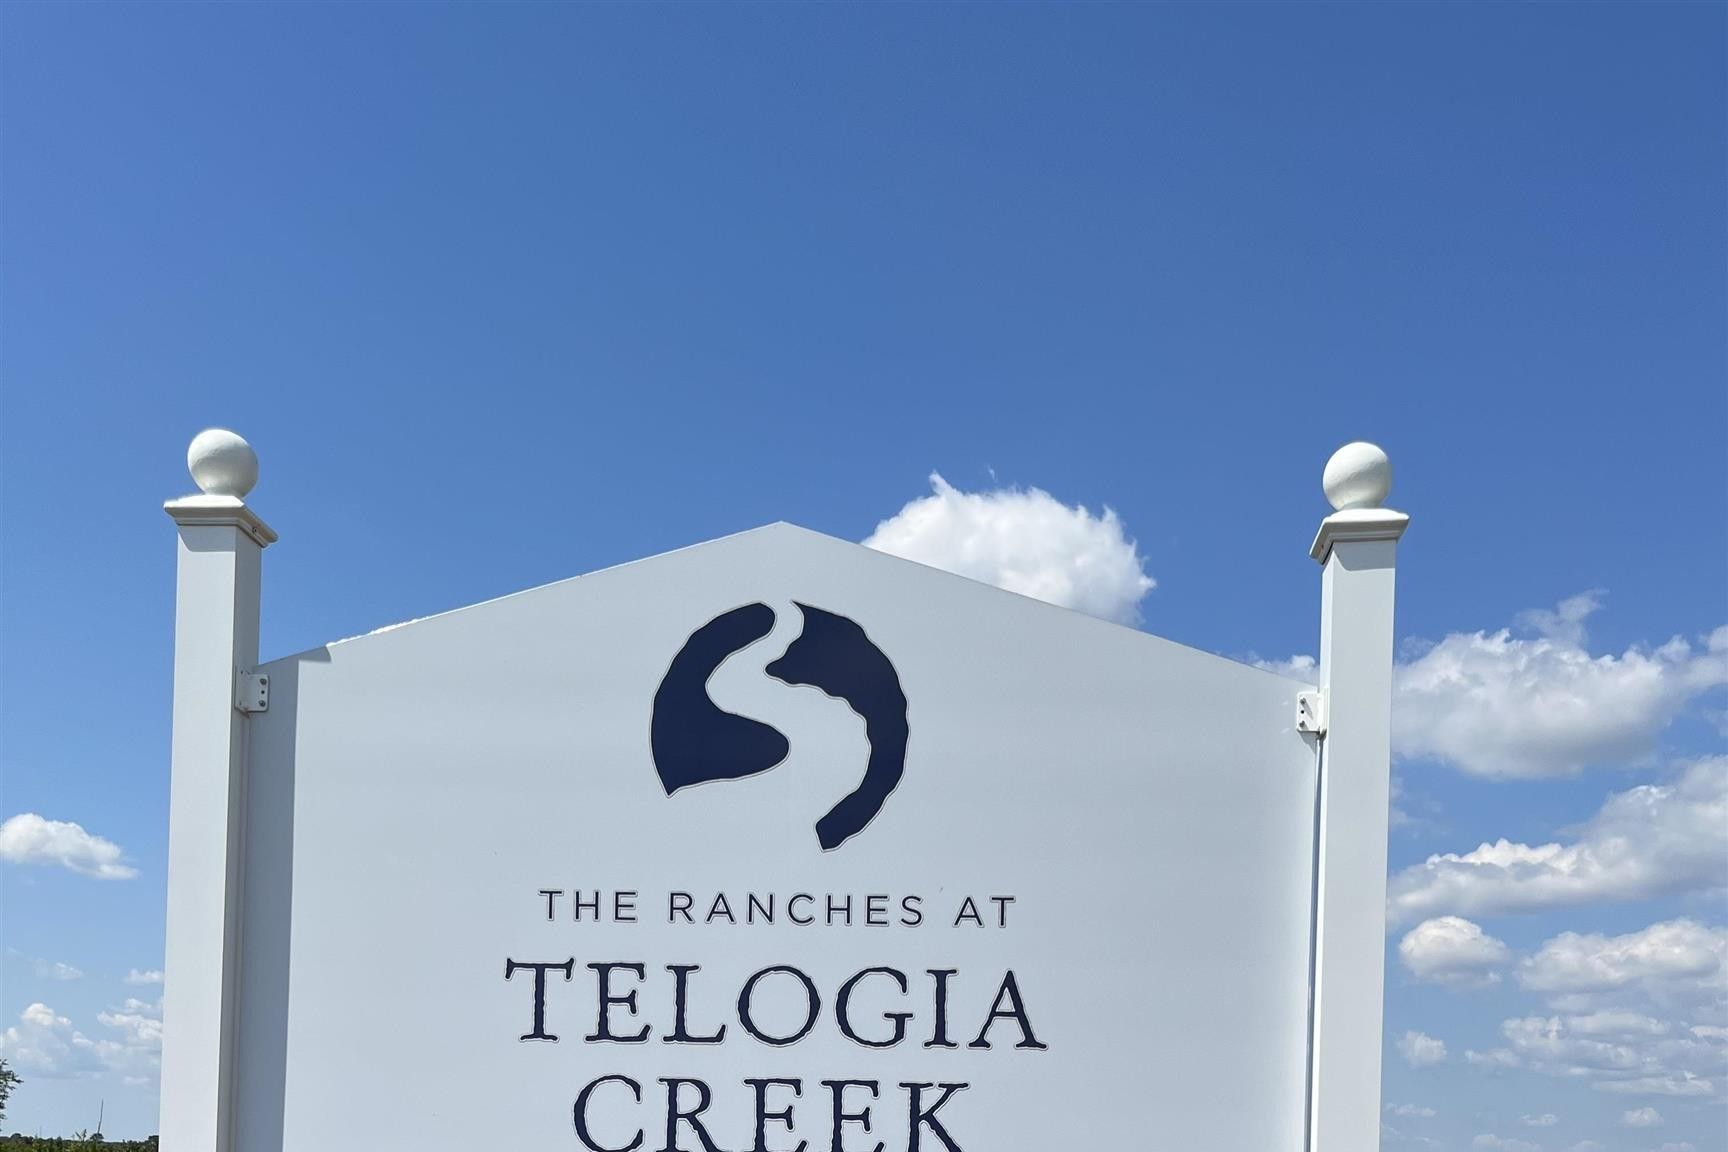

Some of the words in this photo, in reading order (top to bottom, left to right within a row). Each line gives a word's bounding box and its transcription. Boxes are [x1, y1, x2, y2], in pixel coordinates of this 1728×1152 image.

[539, 889, 638, 922] THE
[668, 891, 924, 927] RANCHES
[953, 896, 1016, 928] AT
[504, 957, 1049, 1050] TELOGIA
